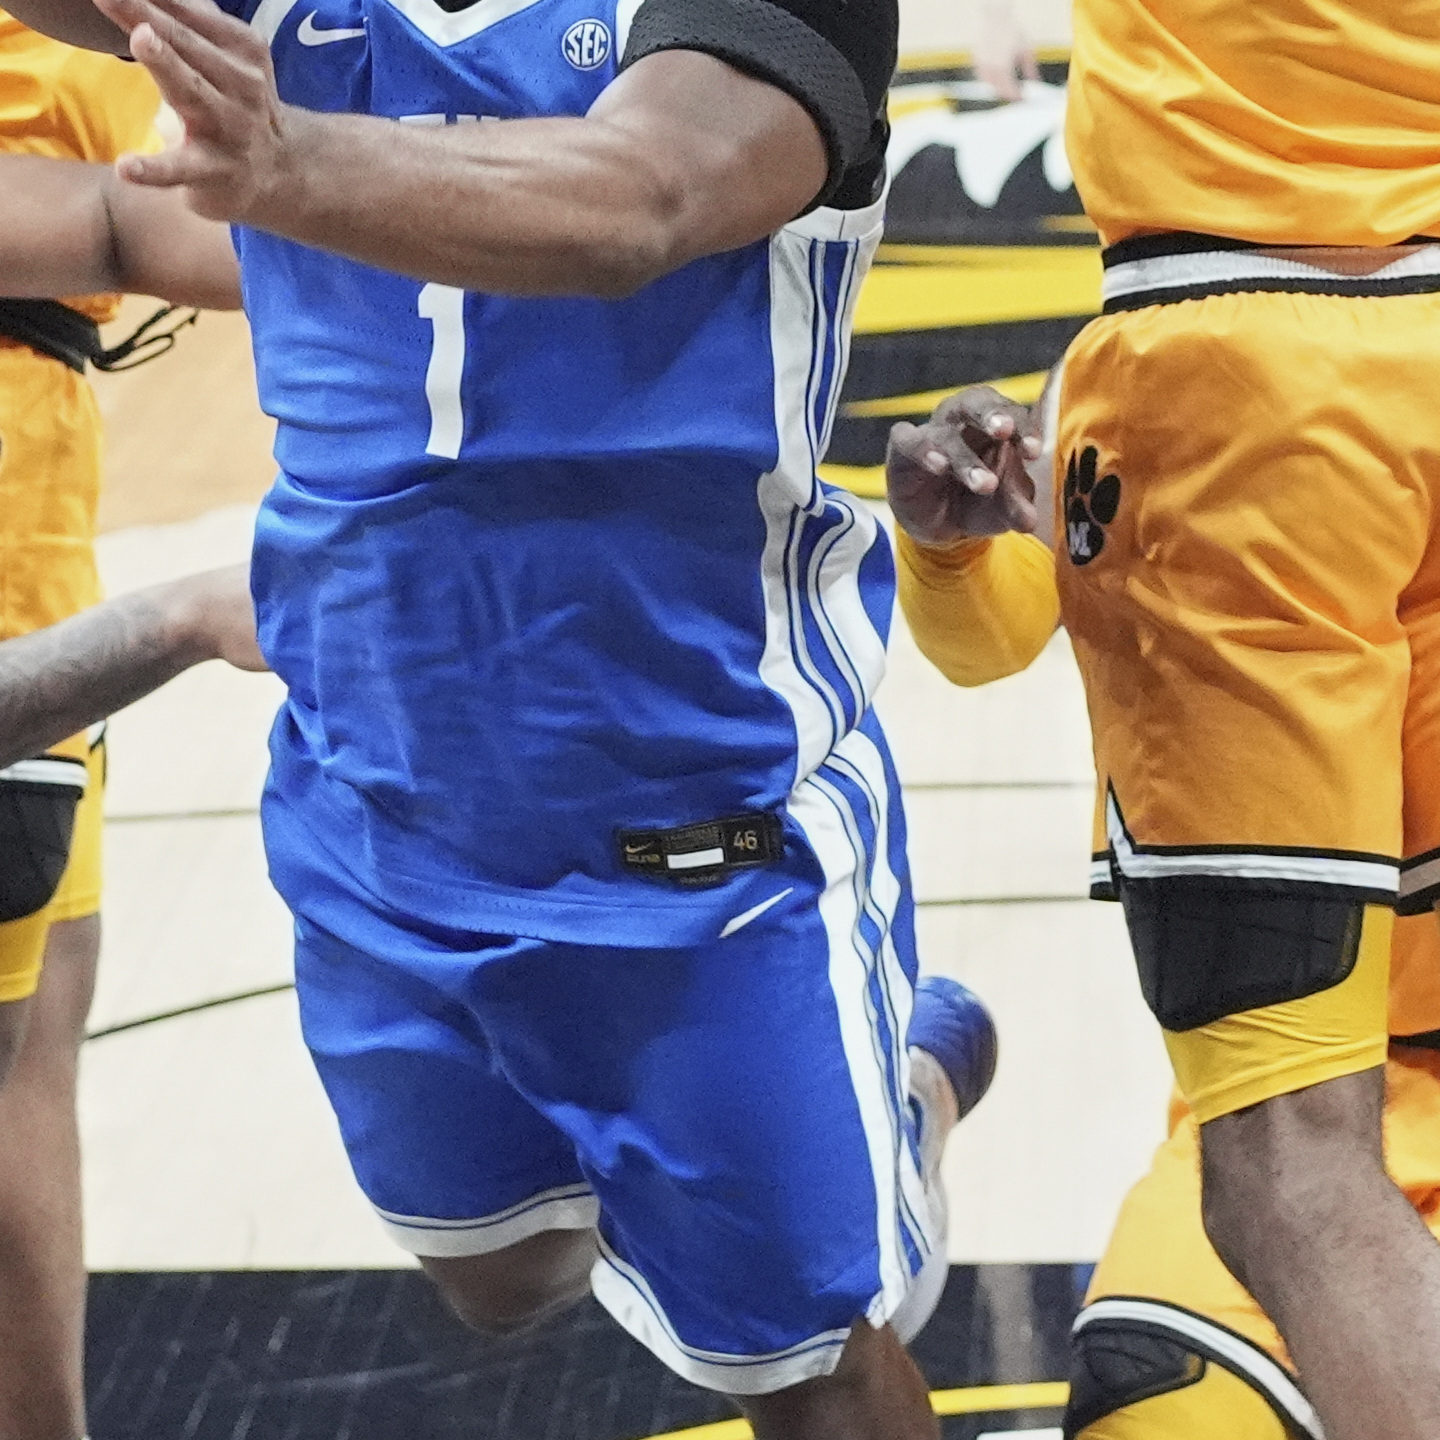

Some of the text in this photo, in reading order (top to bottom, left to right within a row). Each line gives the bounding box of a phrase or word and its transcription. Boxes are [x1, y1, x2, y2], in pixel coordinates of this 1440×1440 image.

[567, 23, 608, 67] SEC
[418, 283, 465, 460] 1
[733, 830, 758, 851] 46
